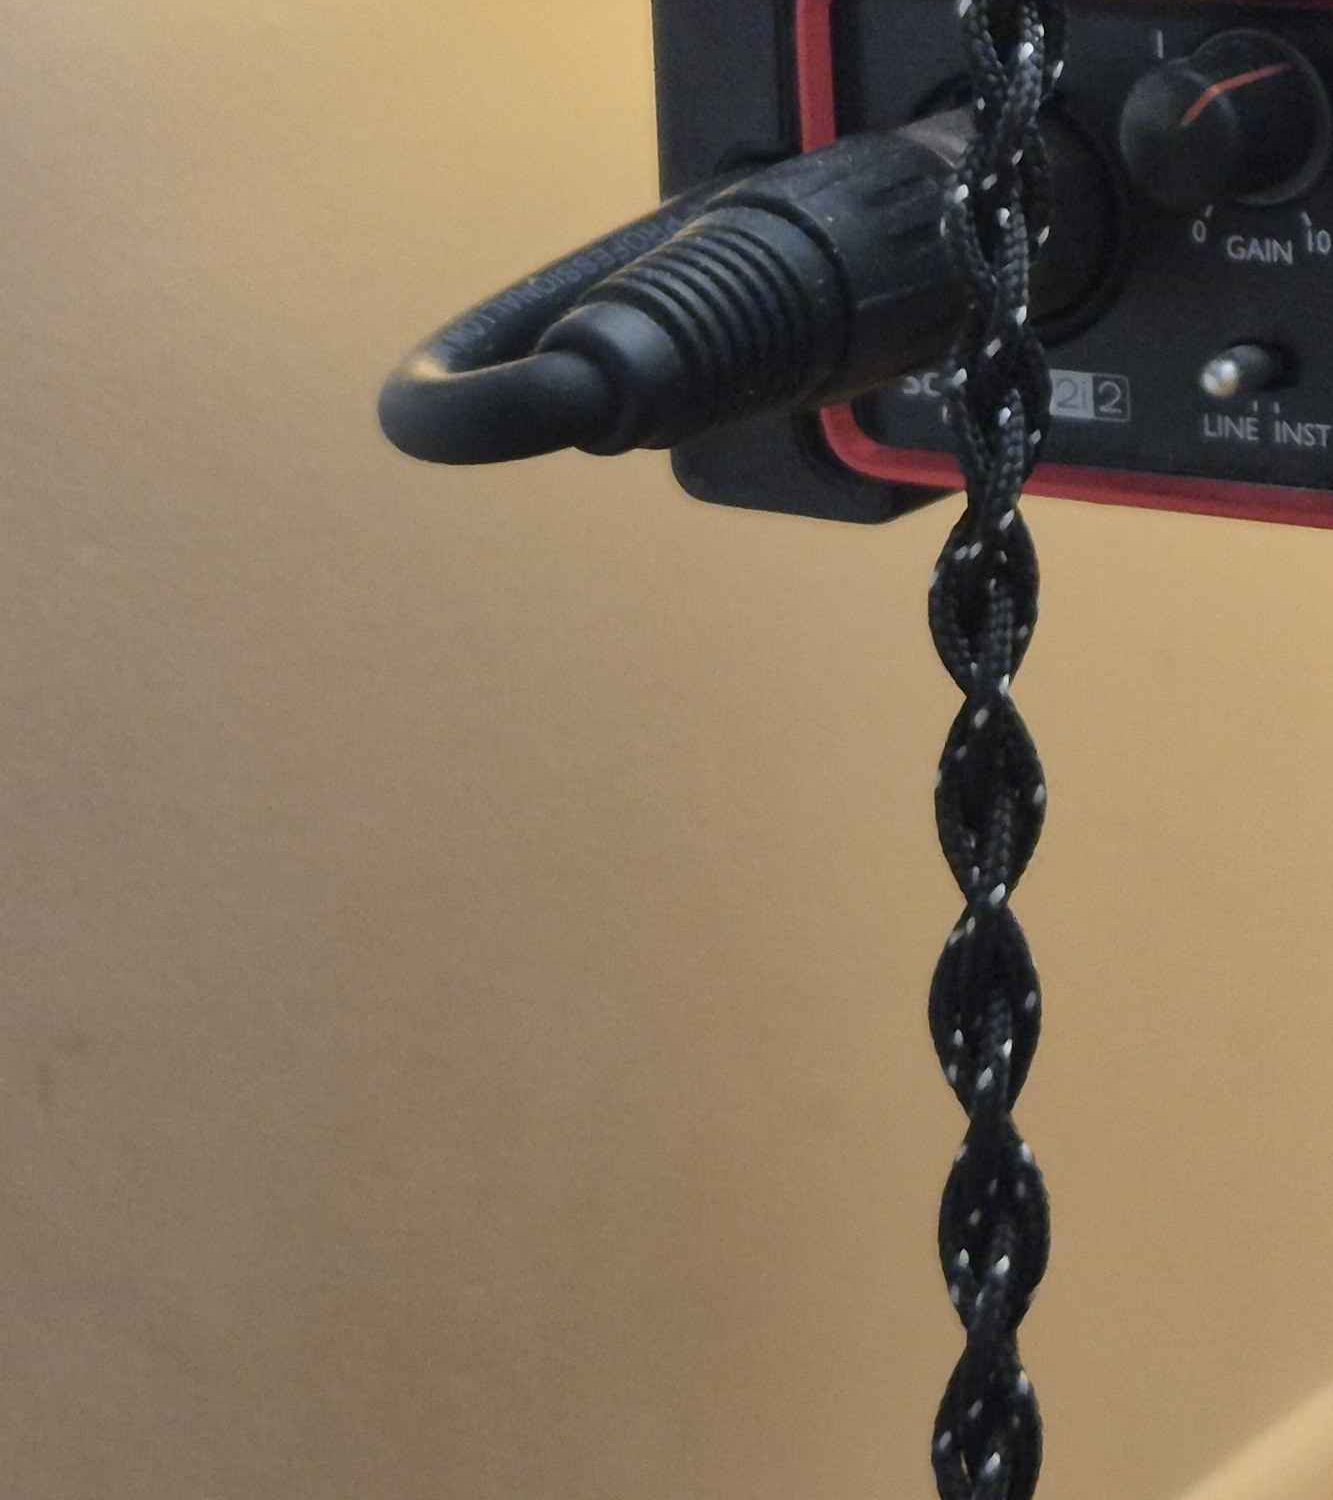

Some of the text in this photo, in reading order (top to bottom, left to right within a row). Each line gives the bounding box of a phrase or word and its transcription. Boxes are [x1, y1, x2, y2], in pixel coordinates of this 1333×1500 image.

[1191, 219, 1207, 243] 0
[1306, 228, 1332, 254] 10
[1226, 234, 1294, 264] GAIN
[1203, 412, 1332, 449] LINE INST
